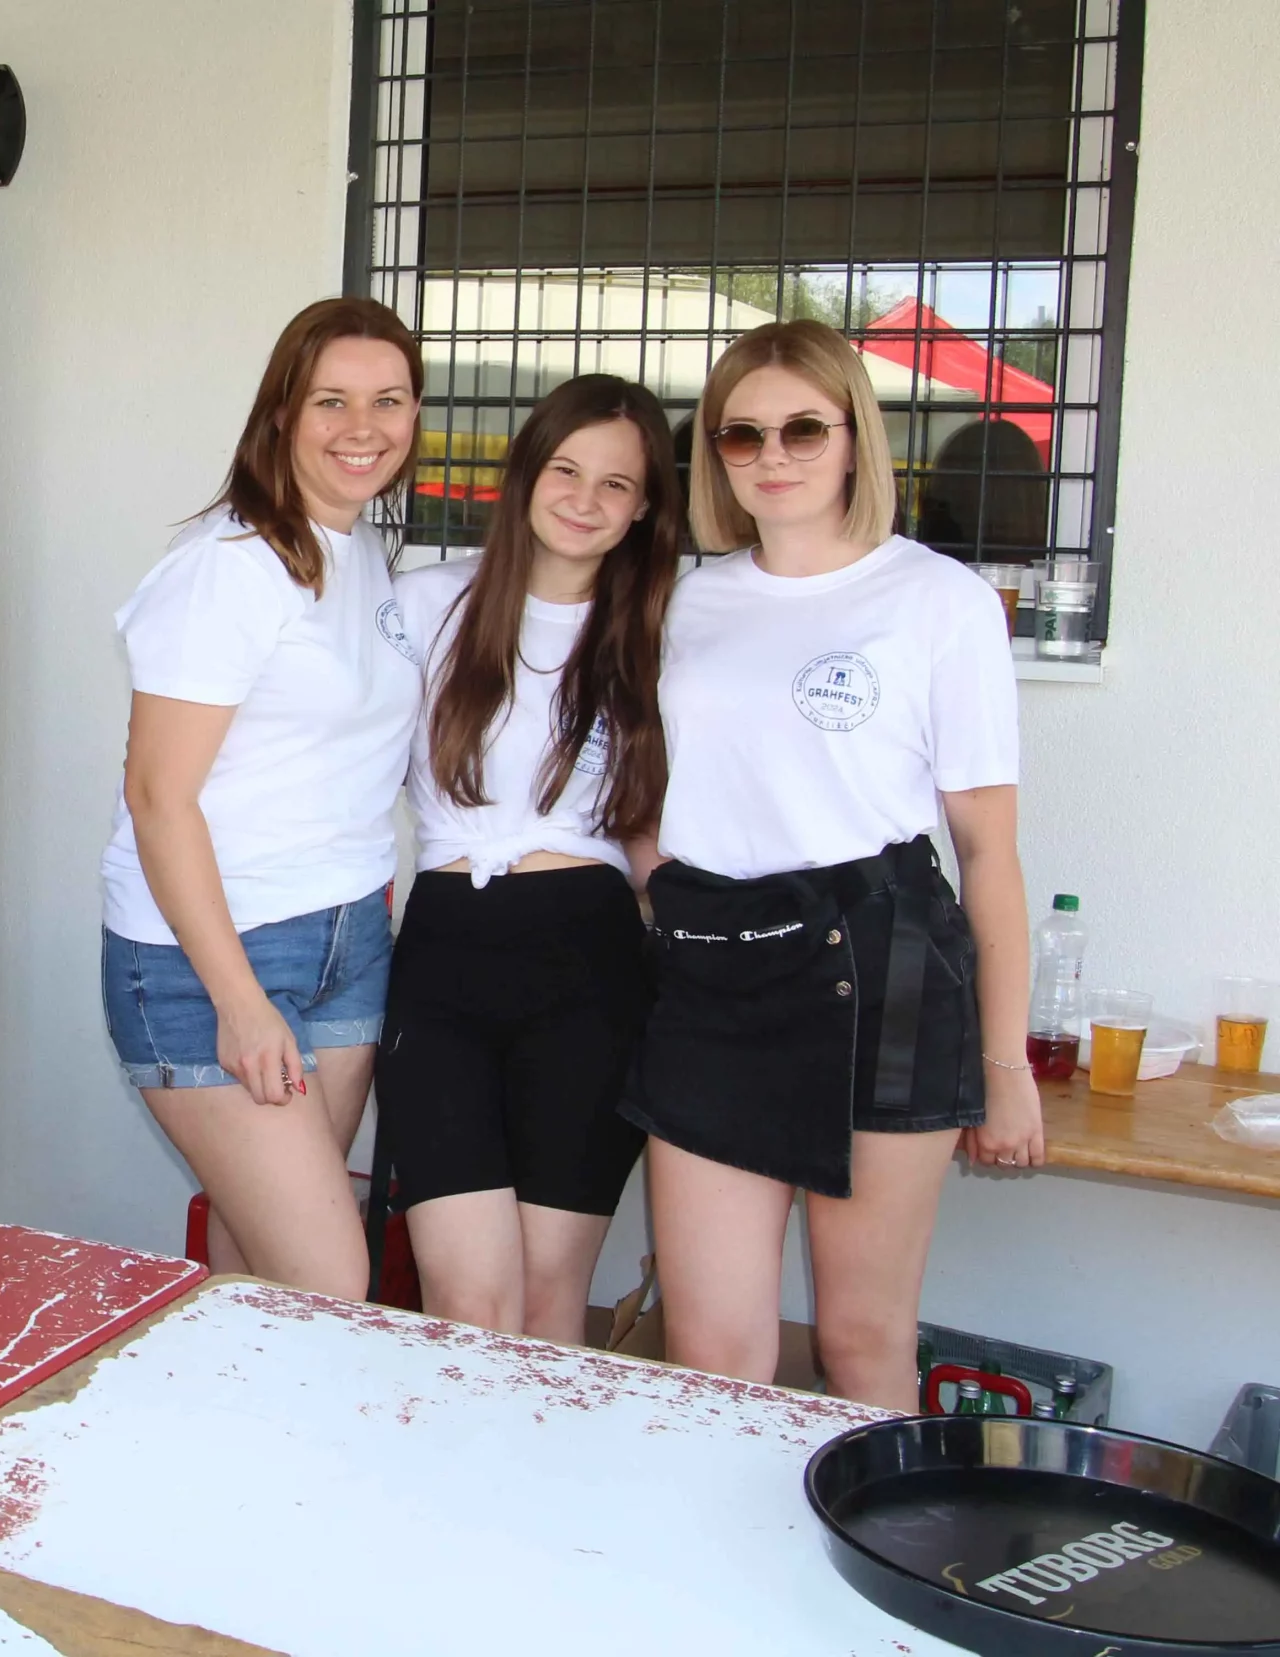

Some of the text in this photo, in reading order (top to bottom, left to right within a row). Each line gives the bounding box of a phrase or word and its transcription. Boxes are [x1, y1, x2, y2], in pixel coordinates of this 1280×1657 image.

[808, 687, 864, 708] GRAHFEST
[673, 929, 728, 943] Champion
[739, 922, 804, 942] Champion
[975, 1521, 1174, 1605] TUBORG
[1147, 1545, 1203, 1570] GOLD
